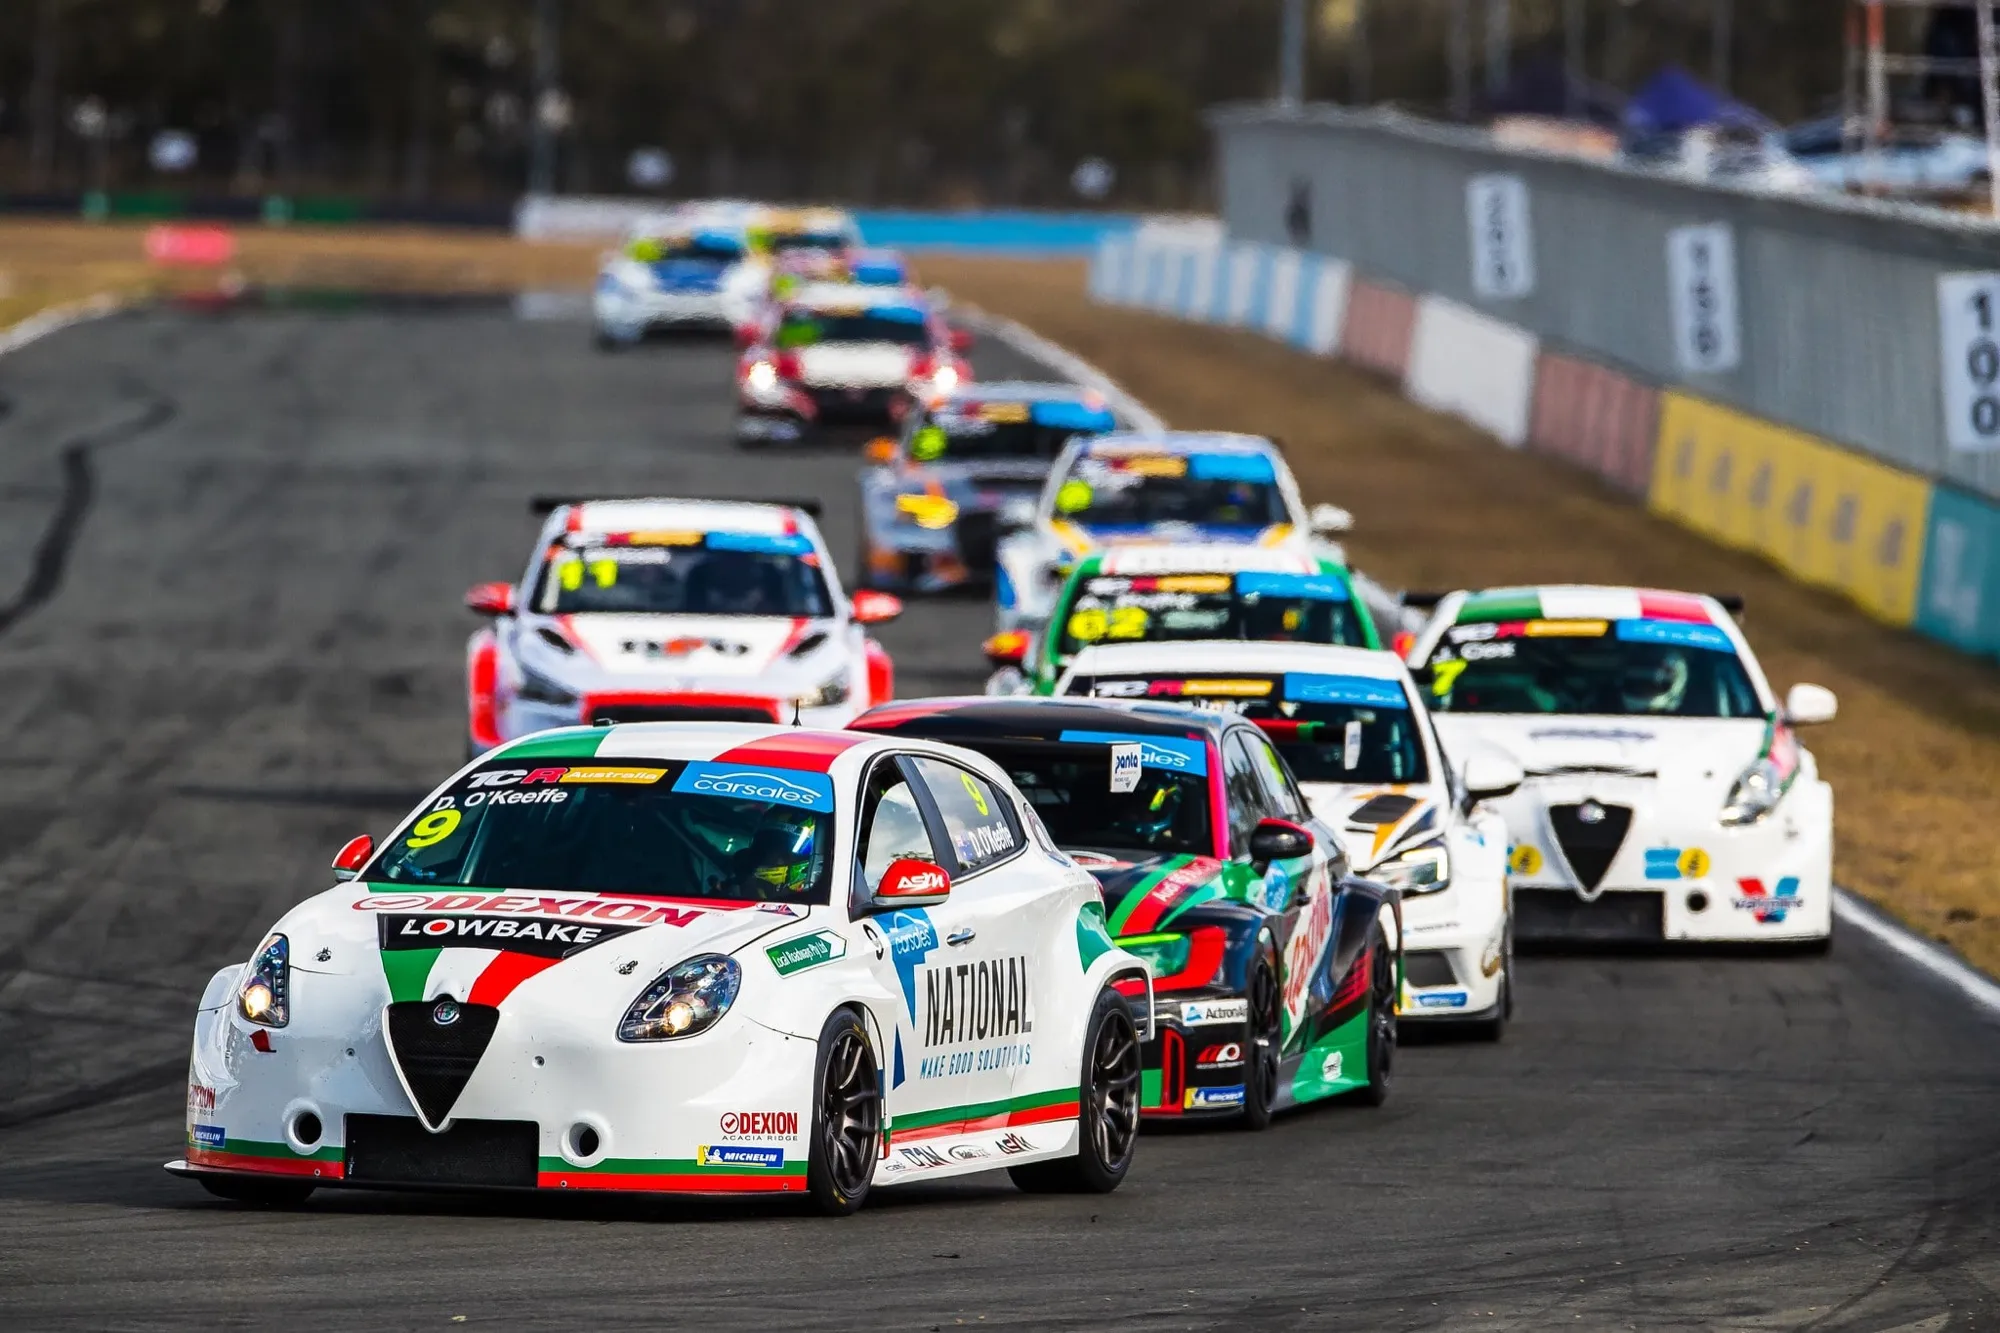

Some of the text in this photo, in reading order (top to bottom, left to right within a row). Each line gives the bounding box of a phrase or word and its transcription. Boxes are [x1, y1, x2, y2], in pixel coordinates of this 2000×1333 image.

[1433, 658, 1467, 696] 7
[467, 767, 658, 789] TCR Australia
[693, 778, 815, 805] carsales
[432, 788, 568, 812] D. O'Keeffe
[961, 772, 989, 816] 9
[406, 809, 461, 848] 9
[424, 894, 706, 928] DEXION
[400, 918, 602, 944] LOWBAKE
[894, 926, 932, 954] carsales
[772, 951, 789, 968] Local
[925, 956, 1032, 1047] NATIONAL
[920, 1043, 1031, 1079] MAKE GOOD SOLUTIONS
[740, 1112, 798, 1135] DEXION
[724, 1152, 778, 1163] MICHELIN
